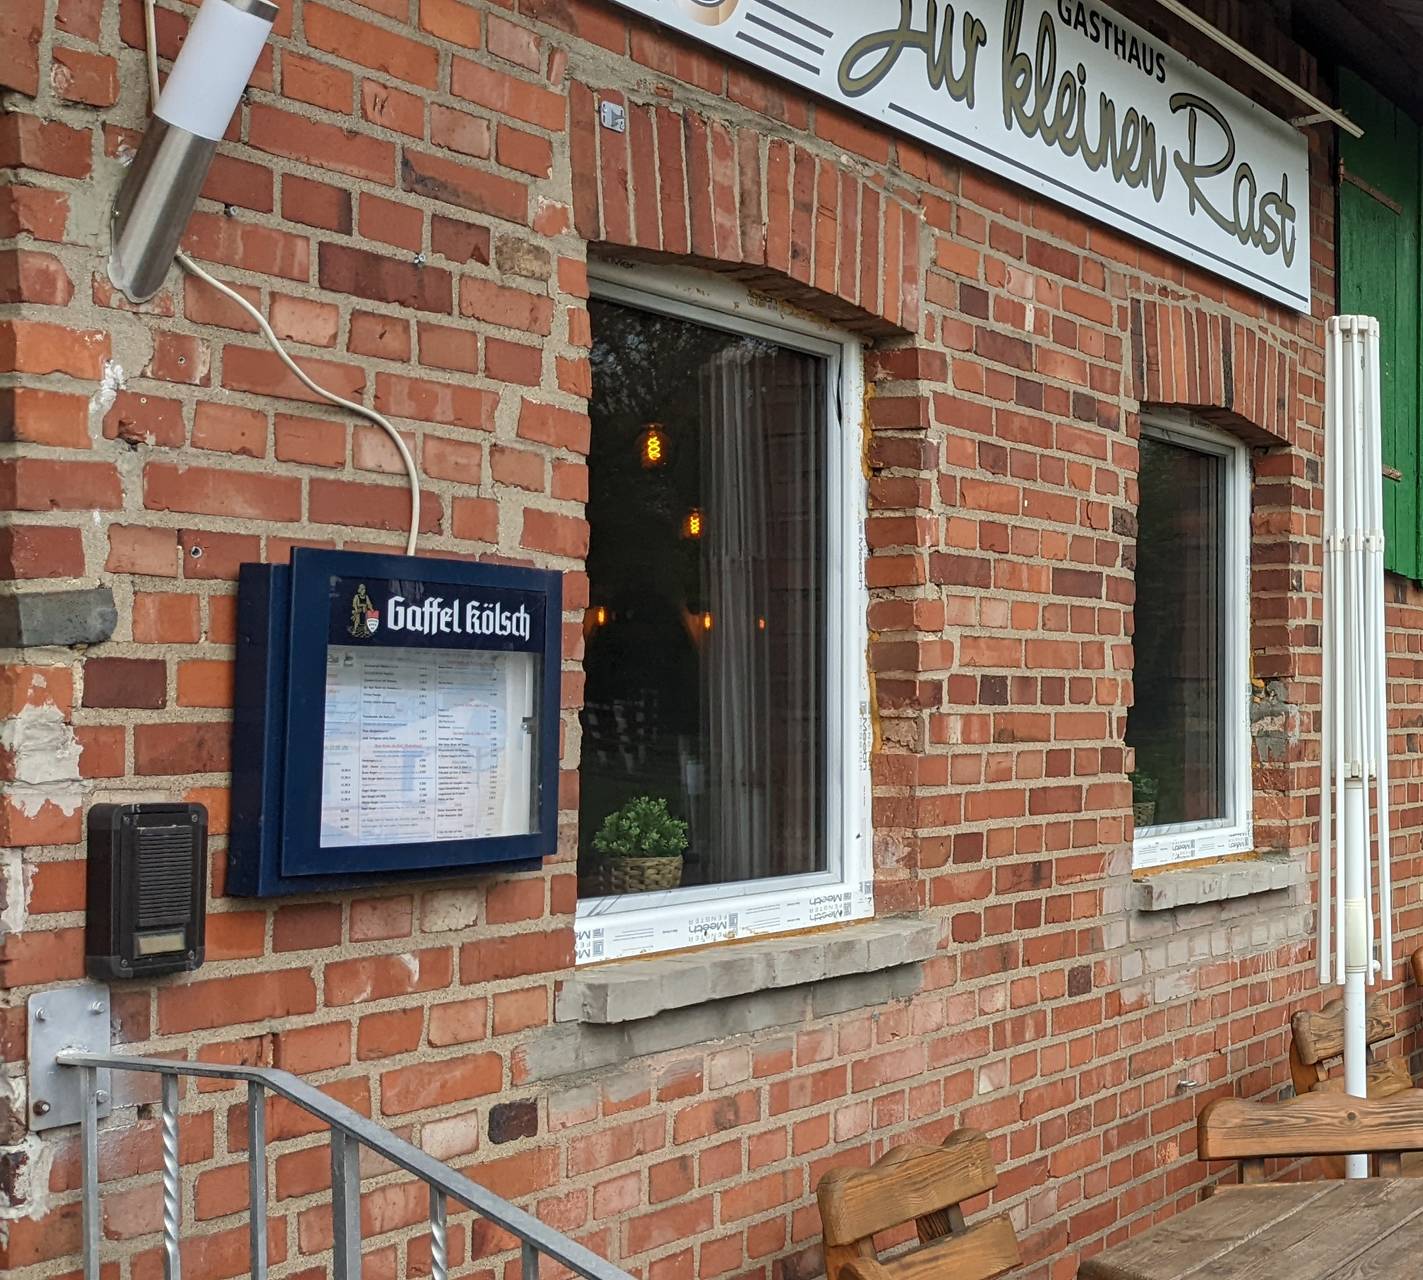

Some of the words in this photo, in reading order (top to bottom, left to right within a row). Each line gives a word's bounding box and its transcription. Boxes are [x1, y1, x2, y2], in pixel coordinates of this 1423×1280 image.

[1057, 0, 1166, 83] GASTHAUS
[1001, 0, 1167, 203] kleinen
[1169, 92, 1296, 268] Rast
[387, 595, 462, 636] Gaffel
[465, 599, 531, 642] Kölsch
[688, 920, 728, 936] Meeth
